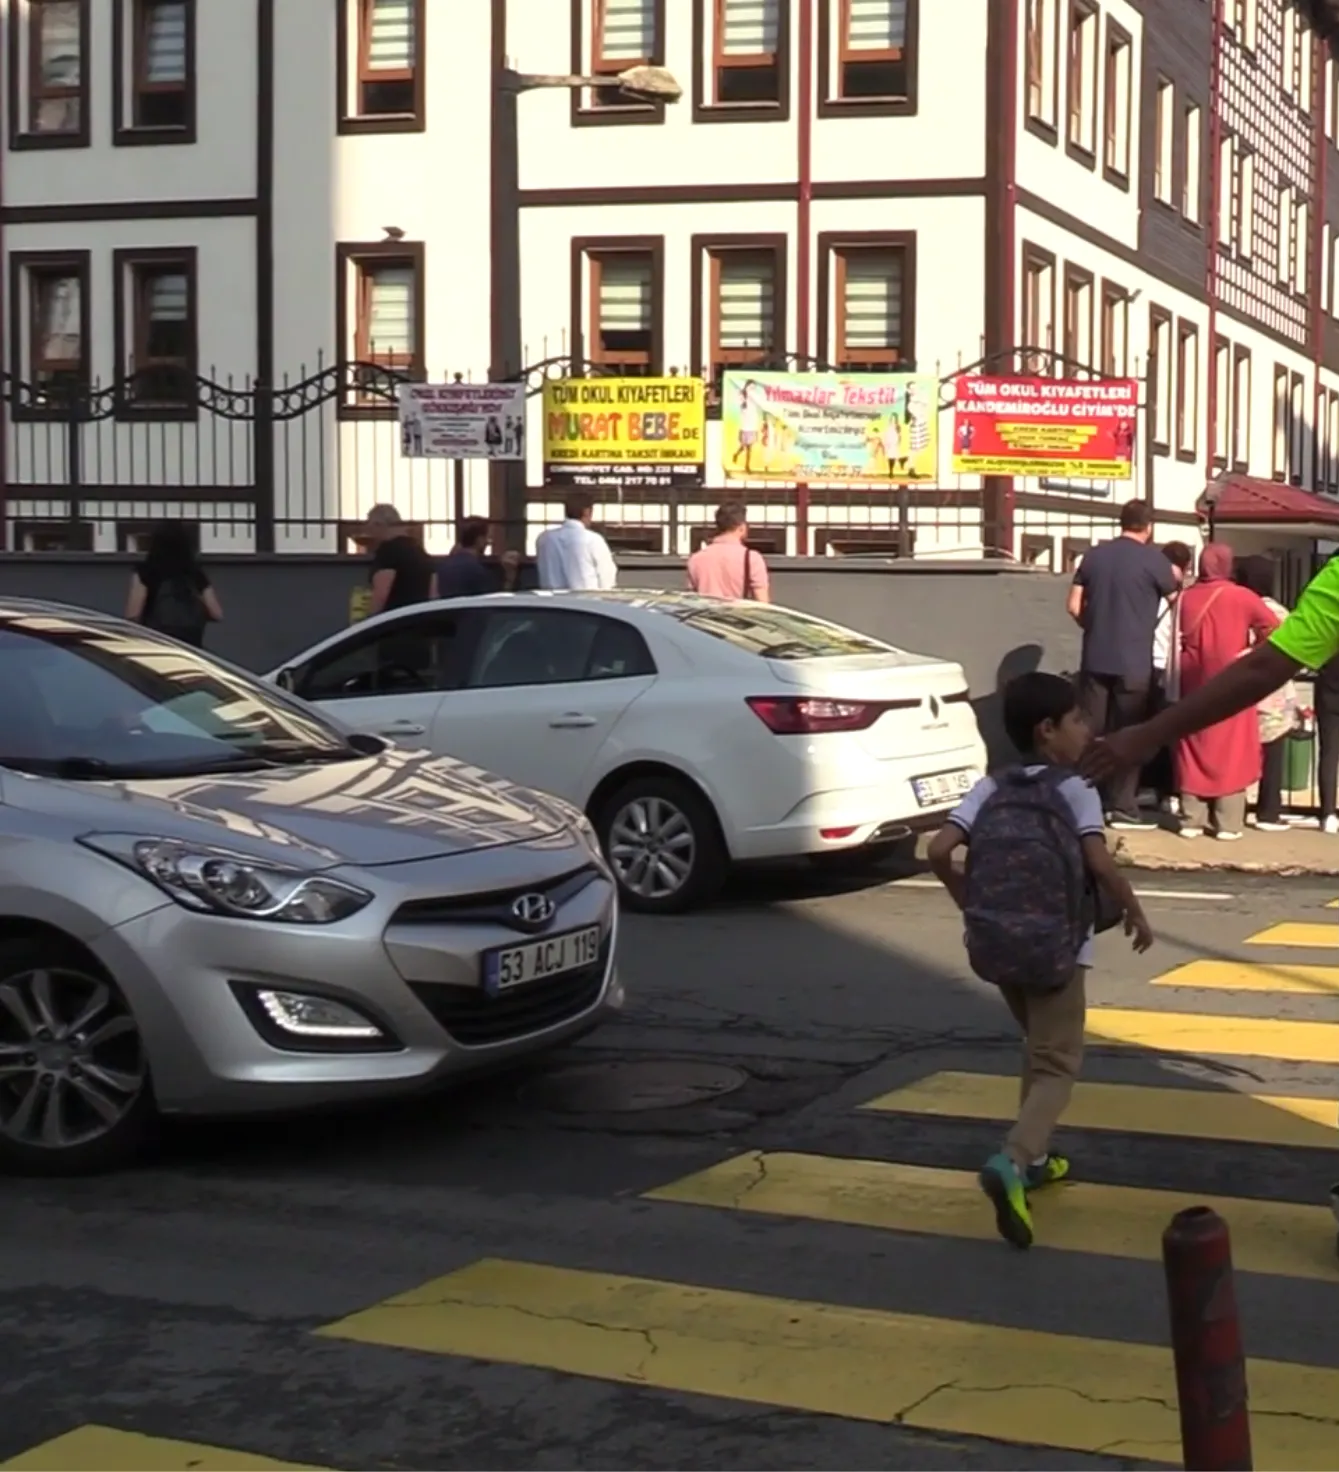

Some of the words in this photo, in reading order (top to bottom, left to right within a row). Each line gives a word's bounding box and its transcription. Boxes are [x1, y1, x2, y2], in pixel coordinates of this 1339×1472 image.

[552, 384, 579, 403] TÜM
[581, 385, 614, 403] OKUL
[617, 384, 695, 404] KIYAFETLERİ
[765, 385, 835, 405] Yılmazlar
[844, 386, 897, 405] Tekstil
[967, 381, 996, 397] TÜM
[1000, 383, 1038, 397] OKUL
[1041, 384, 1132, 400] KIYAFETLERİ
[956, 400, 1069, 417] KANDEMİROĞLU
[549, 411, 622, 441] MURAT
[628, 412, 682, 441] BEBE
[682, 427, 699, 440] DE
[501, 950, 524, 984] 53
[534, 939, 565, 976] ACJ
